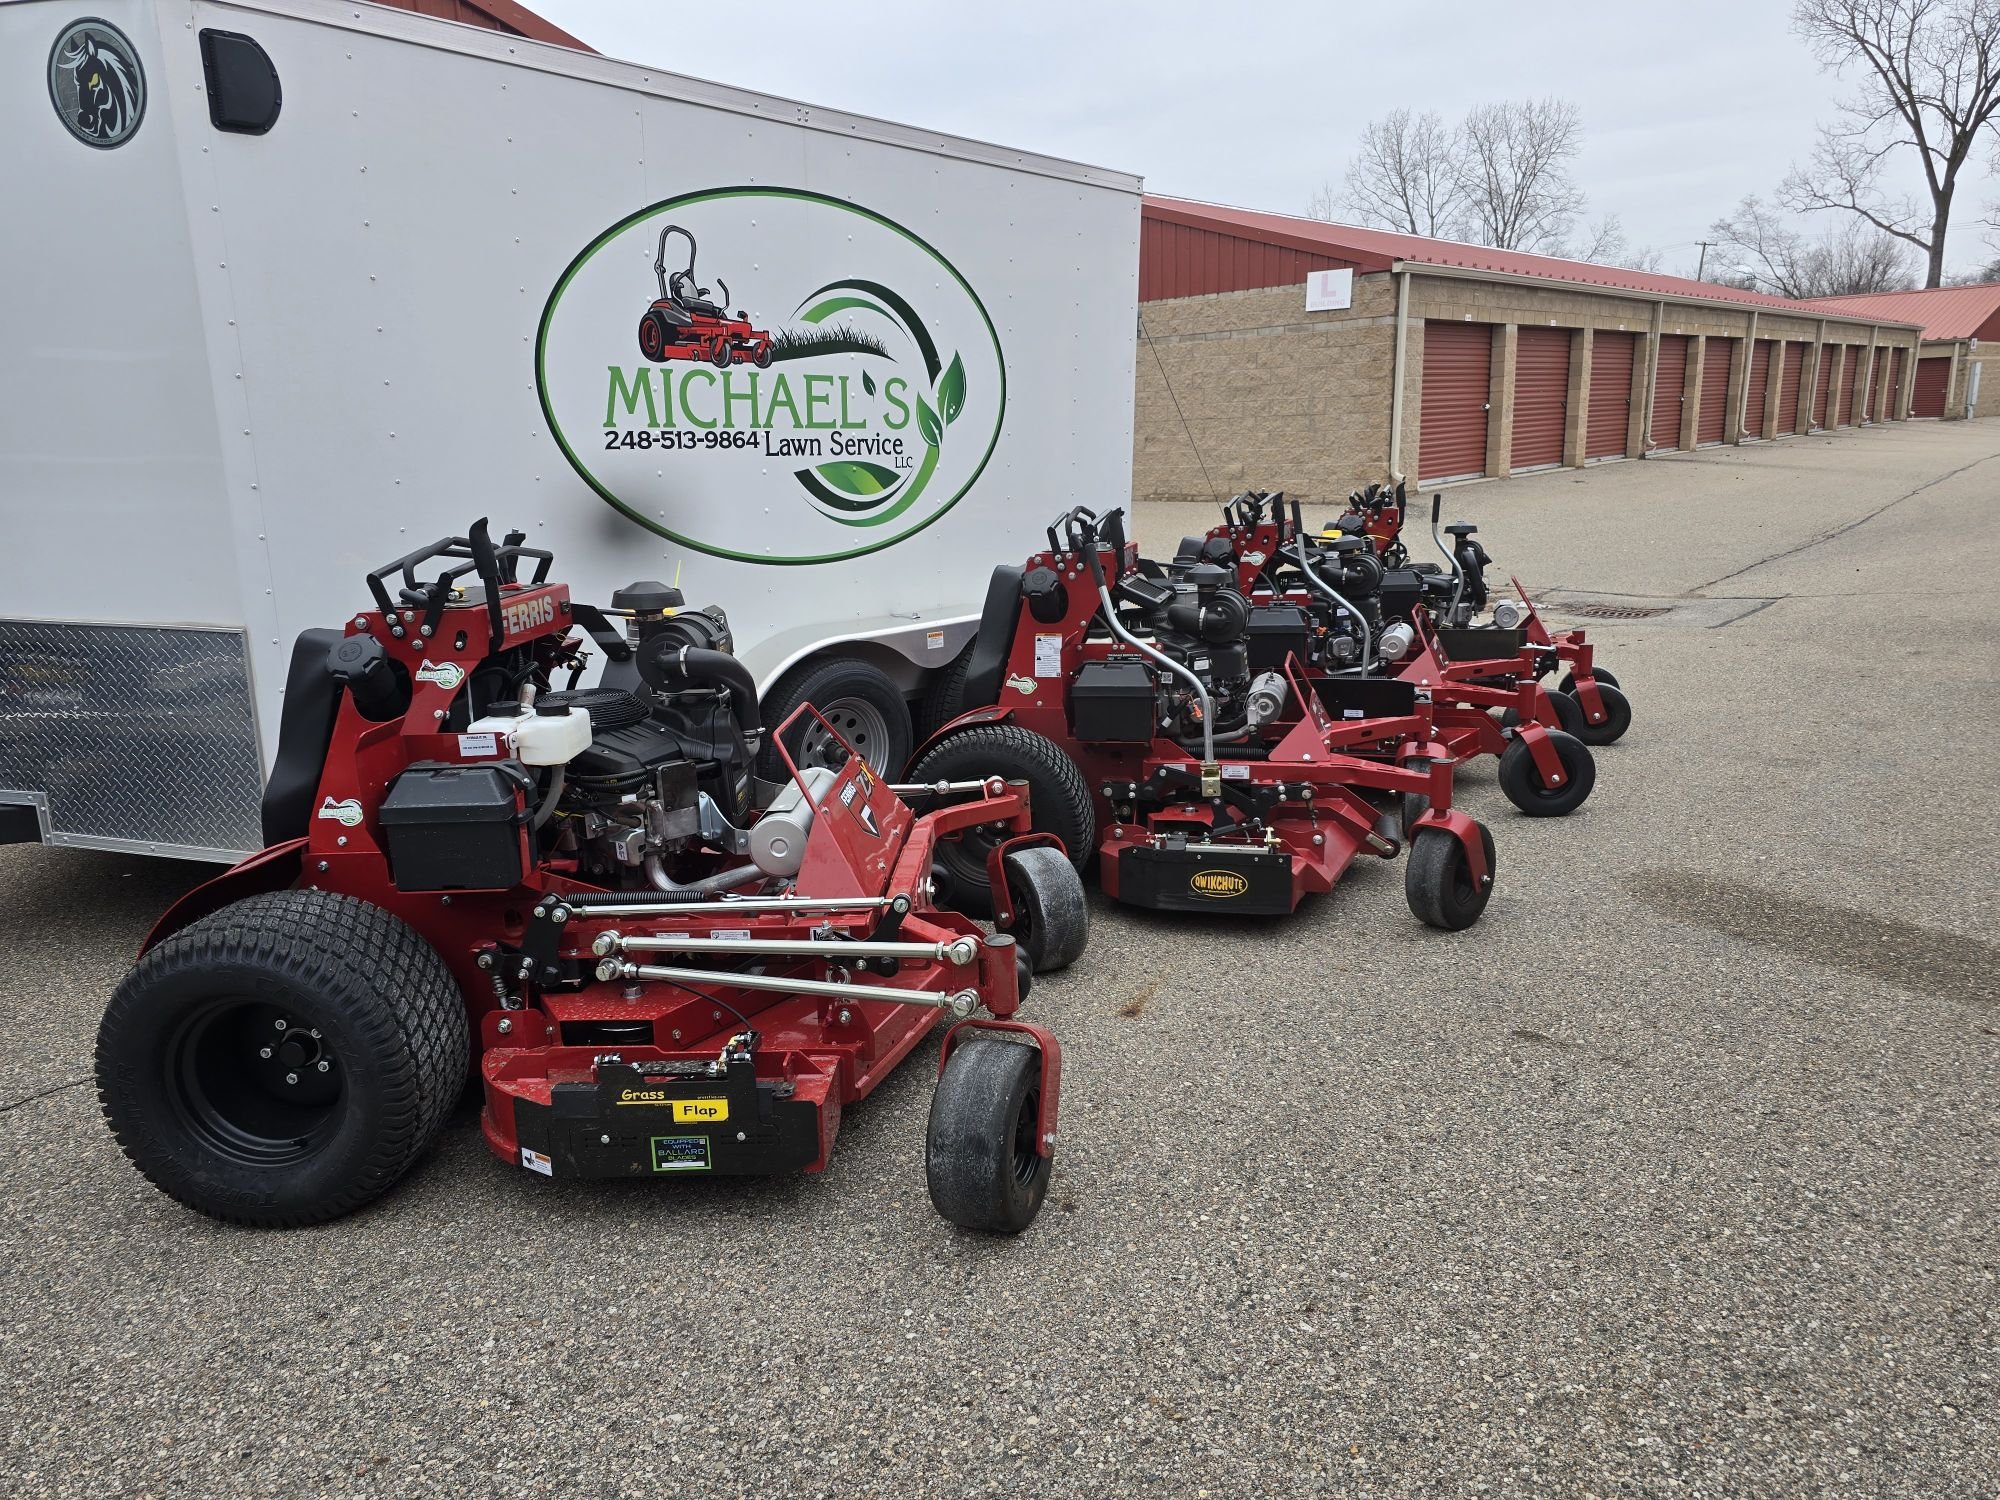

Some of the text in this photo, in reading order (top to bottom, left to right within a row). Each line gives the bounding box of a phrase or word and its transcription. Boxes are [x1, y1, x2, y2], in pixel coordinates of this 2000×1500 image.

[1321, 274, 1336, 298] L
[603, 366, 910, 429] MICHAEL'S
[604, 430, 759, 450] 248-513-9864
[765, 431, 903, 456] Lawn Service
[895, 457, 913, 468] LLC
[1195, 875, 1243, 891] QWIKCHUTE
[622, 1089, 665, 1100] Grass
[683, 1105, 718, 1117] Flap
[658, 1148, 705, 1156] BALLARD
